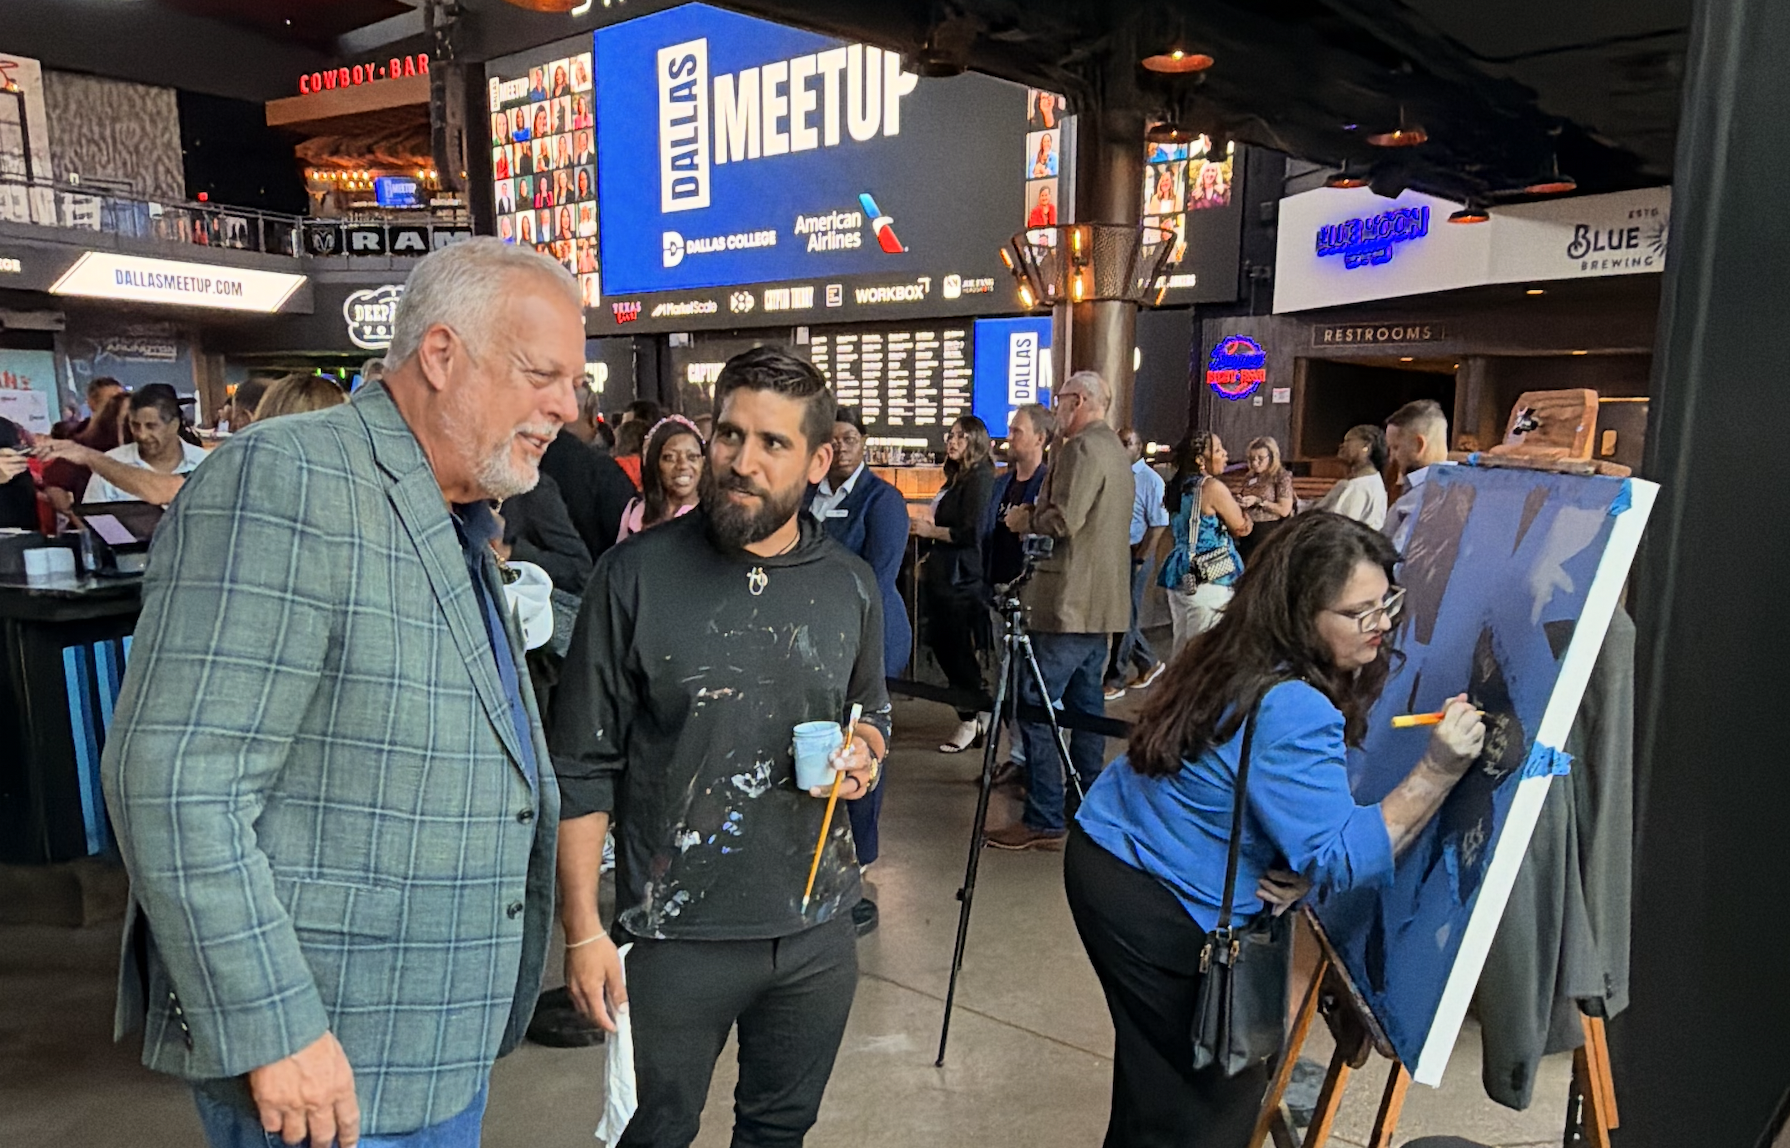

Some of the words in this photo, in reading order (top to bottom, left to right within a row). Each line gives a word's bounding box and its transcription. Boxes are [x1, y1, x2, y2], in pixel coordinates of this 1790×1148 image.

[299, 62, 376, 95] COWBOY
[389, 53, 430, 79] BAR
[713, 43, 919, 165] MEETUP
[668, 53, 699, 200] DALLAS
[794, 210, 862, 235] American
[686, 235, 726, 255] DALLAS
[726, 230, 777, 250] COLLEGE
[807, 232, 862, 253] Airlines
[1567, 224, 1640, 259] BLUE
[1581, 256, 1654, 271] BREWING
[115, 269, 243, 297] DALLASMEETUP.COM
[855, 285, 924, 304] WORKBOX
[354, 304, 390, 322] DEEP
[1323, 326, 1431, 342] RESTROOMS
[1015, 338, 1031, 399] DALLAS
